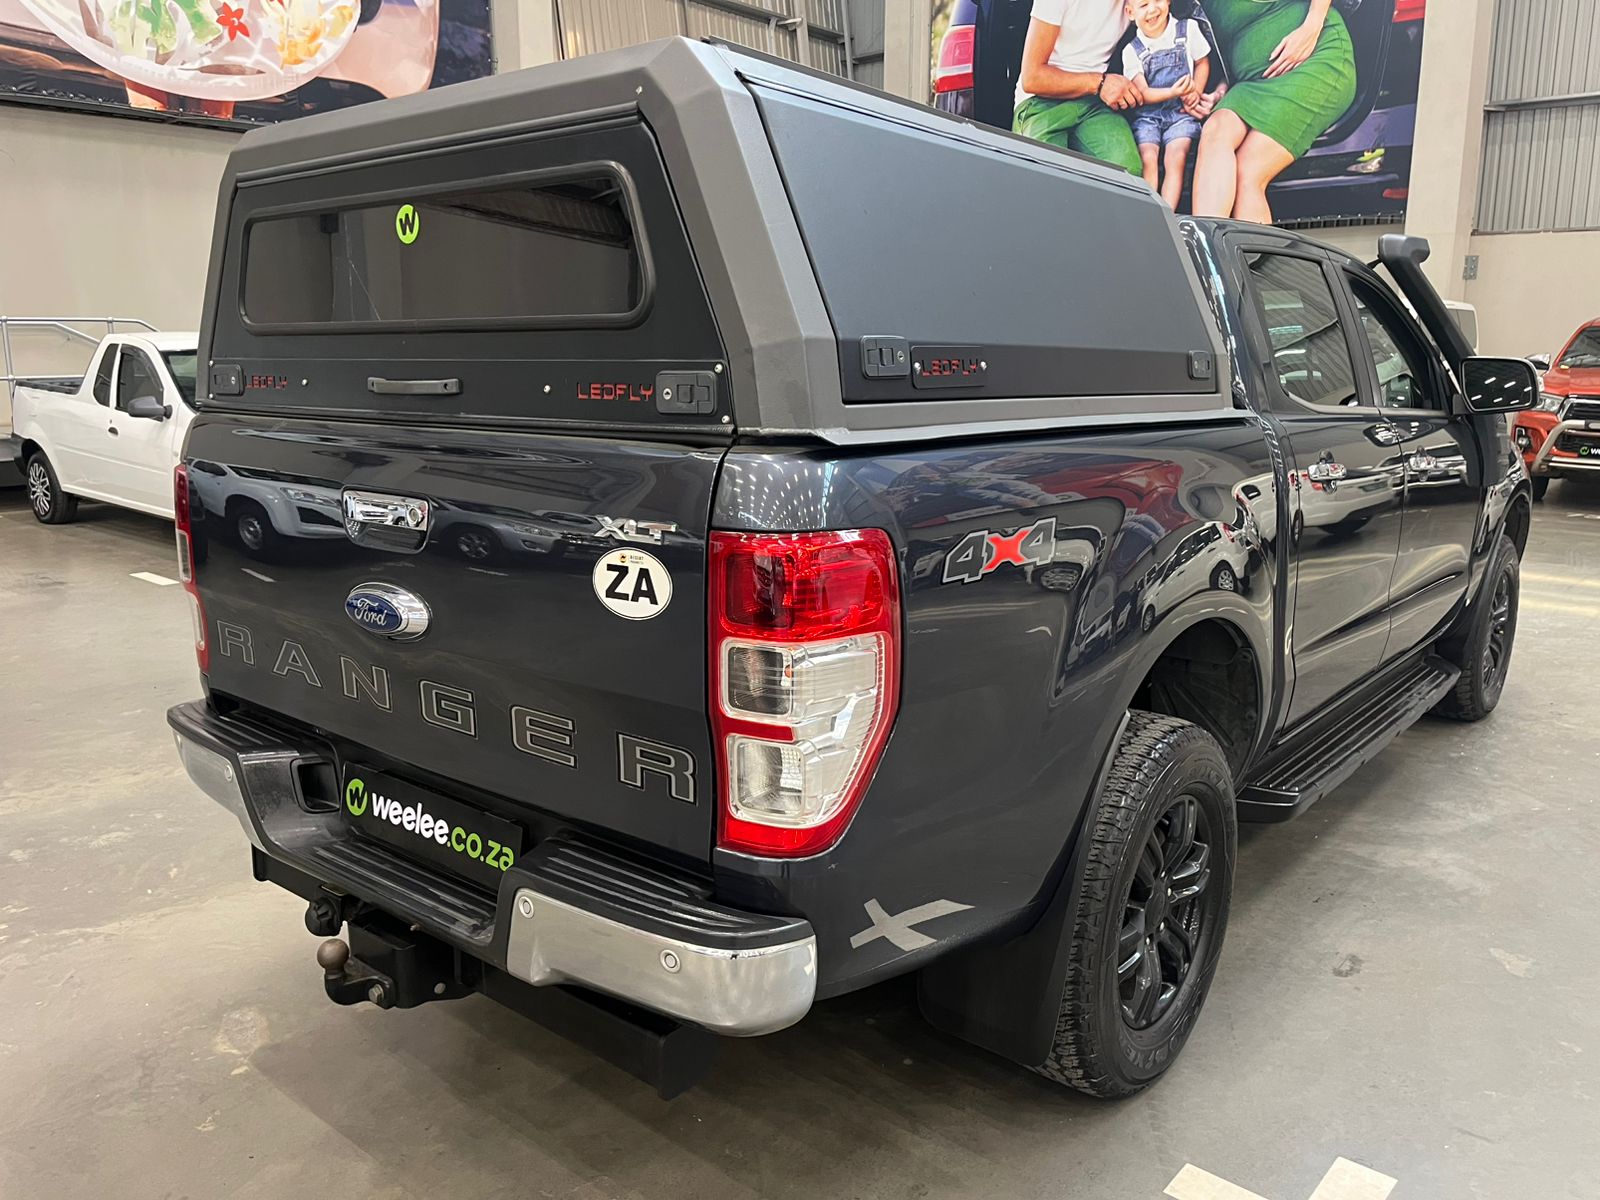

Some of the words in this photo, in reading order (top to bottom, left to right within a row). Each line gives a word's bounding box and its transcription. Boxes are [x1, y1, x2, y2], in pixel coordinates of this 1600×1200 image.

[577, 382, 654, 402] LEDFLY
[594, 515, 678, 546] XLT
[605, 563, 659, 606] ZA
[354, 597, 388, 626] Ford
[217, 619, 698, 805] RANGER
[372, 792, 515, 872] weelee.co.za
